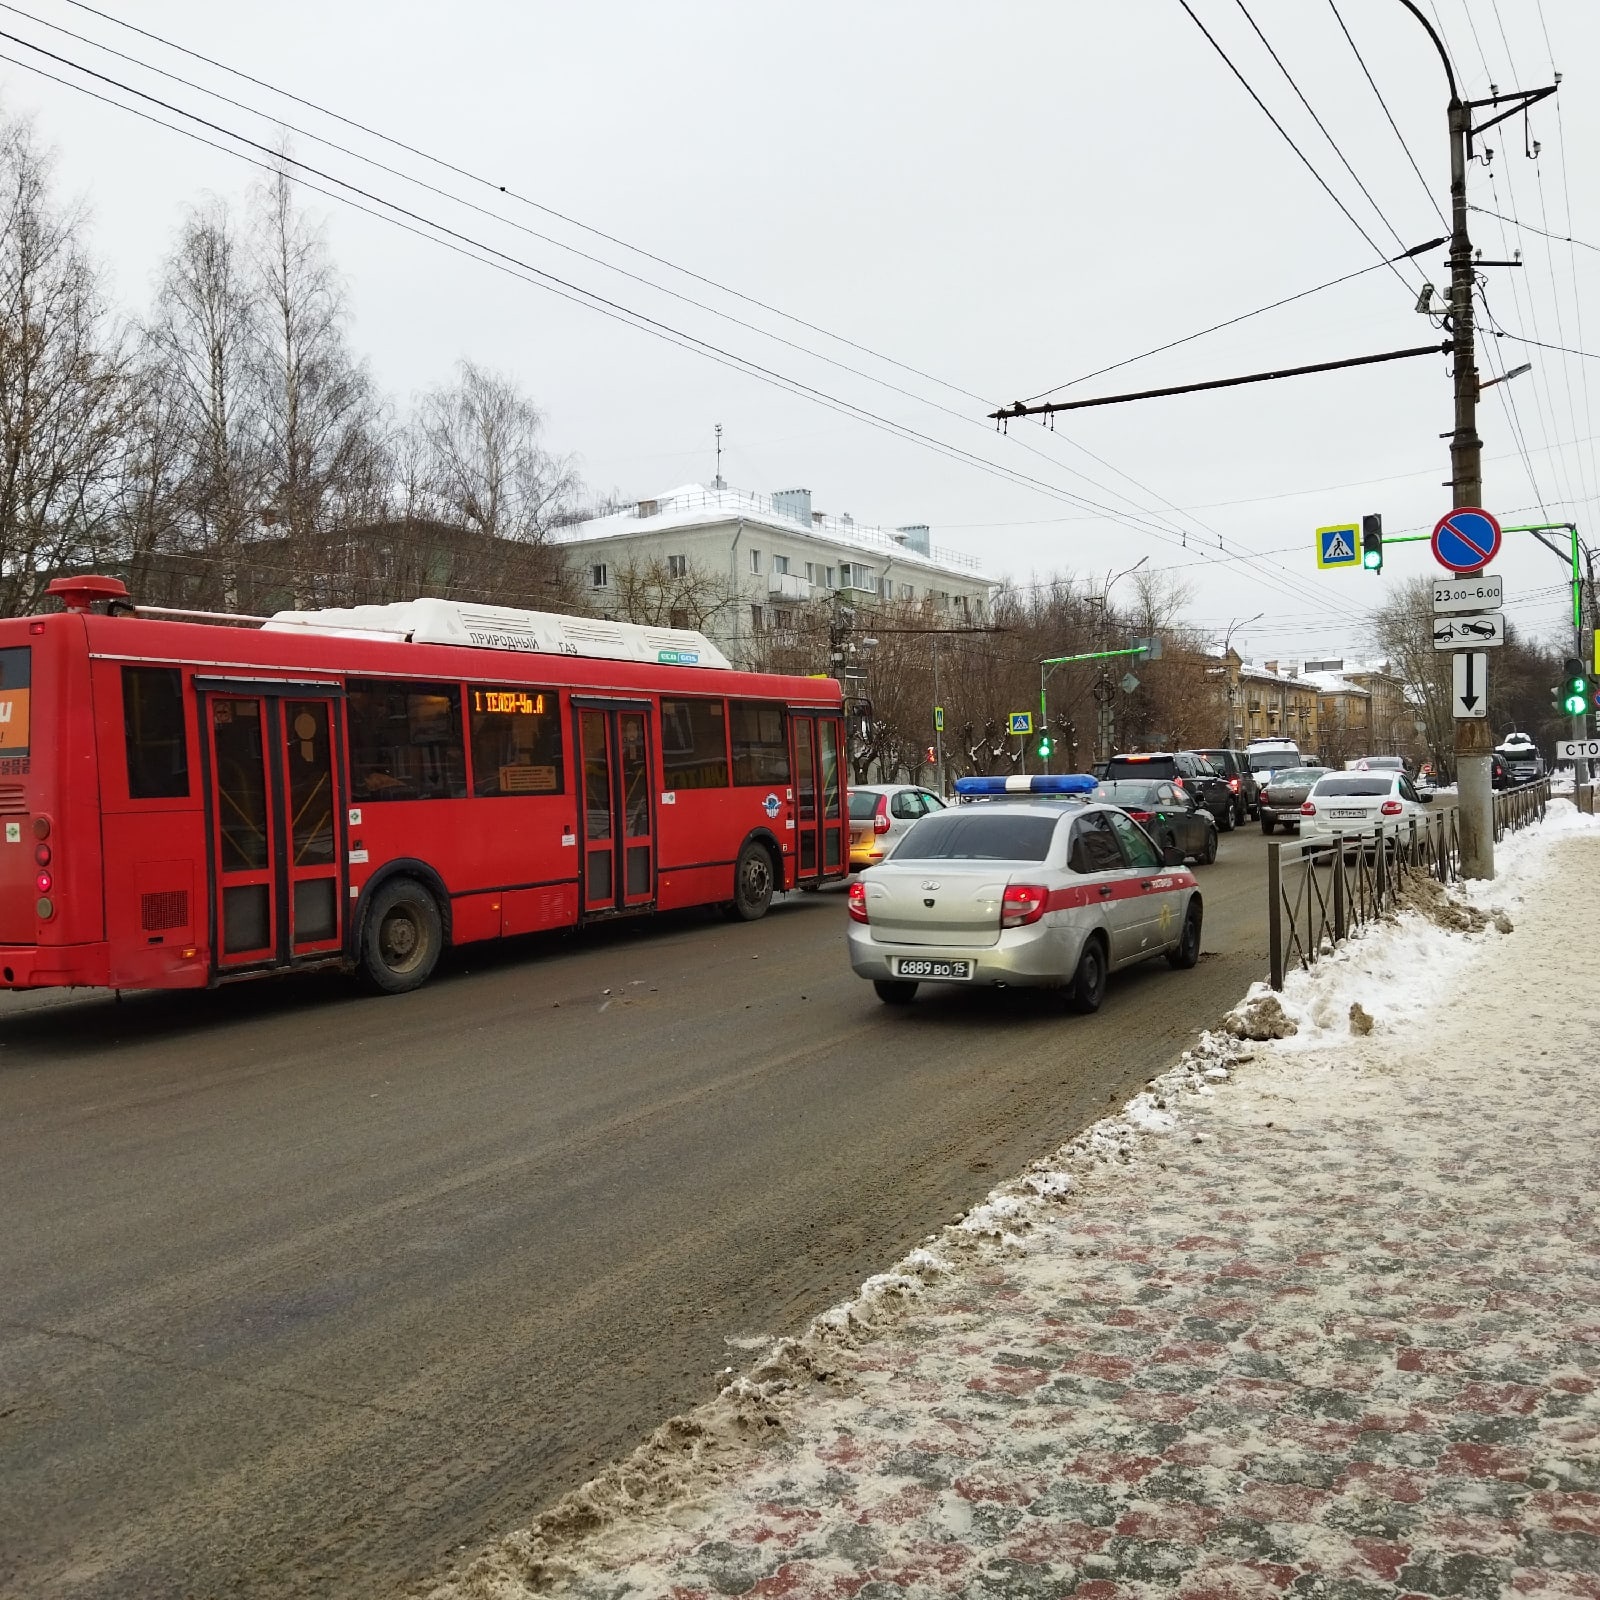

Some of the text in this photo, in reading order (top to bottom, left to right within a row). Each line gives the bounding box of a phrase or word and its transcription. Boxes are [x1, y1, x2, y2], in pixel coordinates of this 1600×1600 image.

[470, 632, 578, 655] ПРИРОДНЫЙ ГАЗ
[1565, 742, 1599, 756] СТО
[900, 960, 932, 975] 6889
[952, 962, 966, 973] 15
